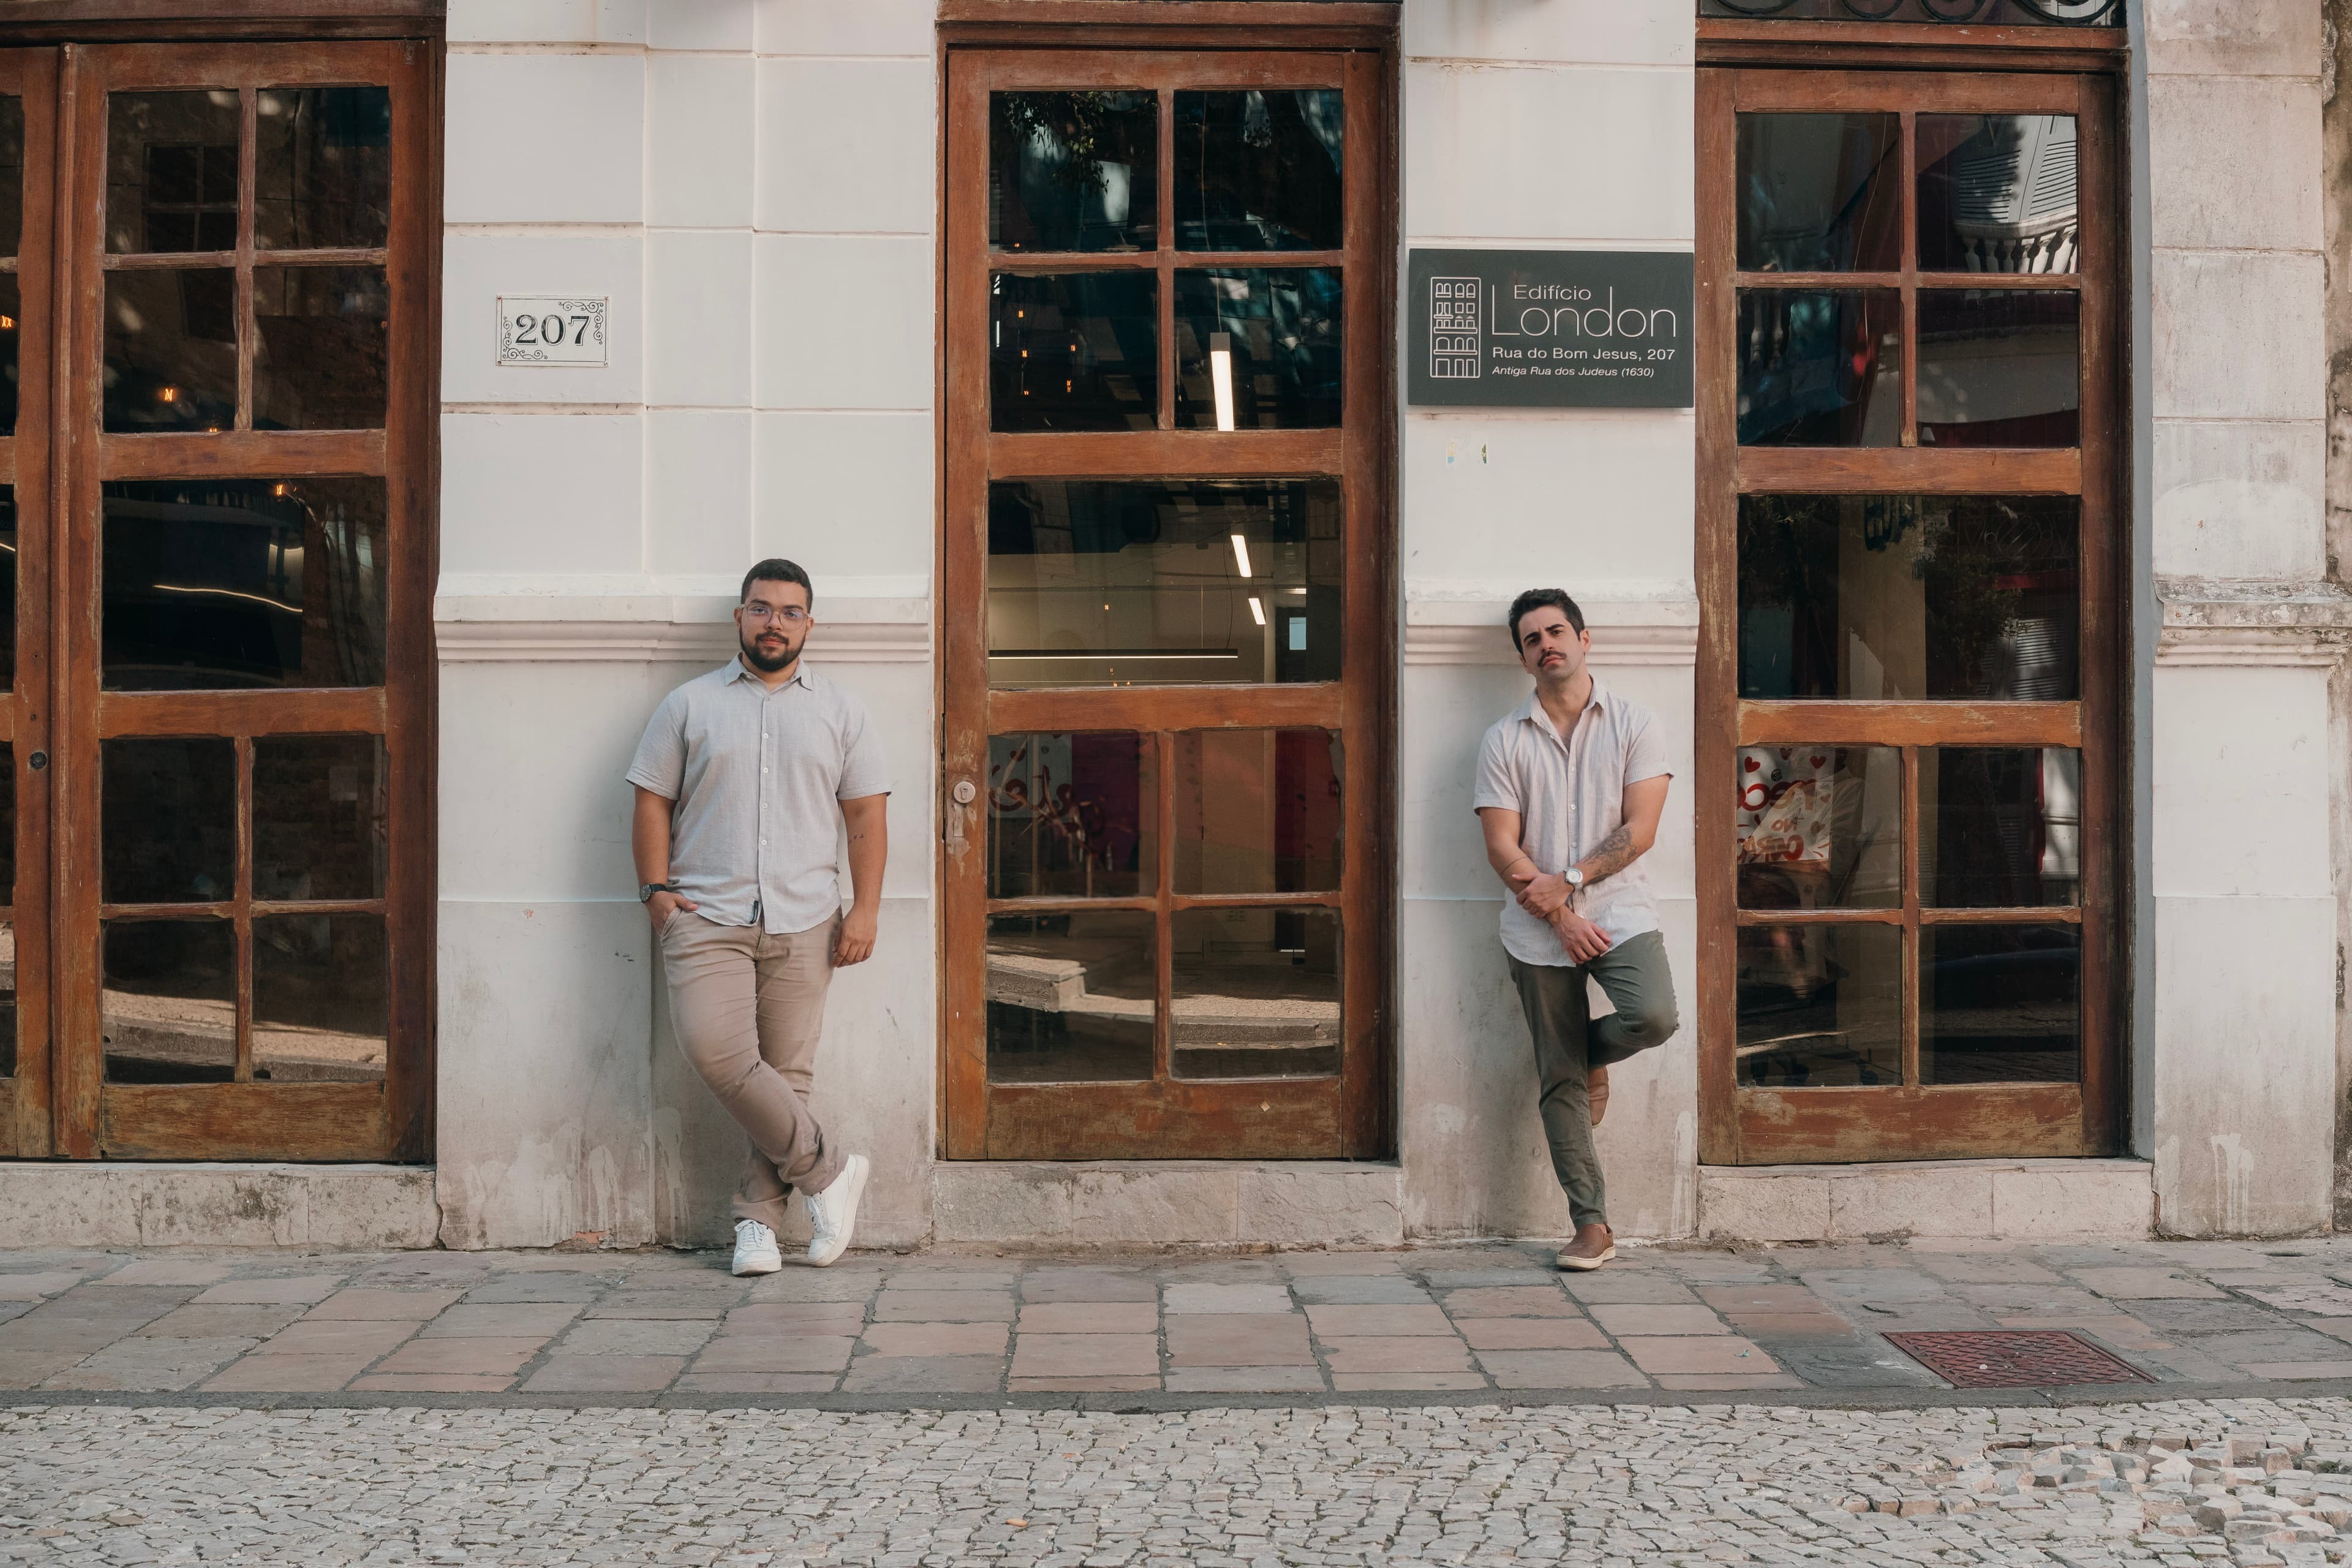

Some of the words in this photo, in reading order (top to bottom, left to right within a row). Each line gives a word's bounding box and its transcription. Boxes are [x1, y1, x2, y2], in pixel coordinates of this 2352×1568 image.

[1514, 284, 1591, 300] Edifício
[1492, 284, 1676, 337] London
[516, 314, 591, 345] 207
[1493, 346, 1522, 358] Rua
[1528, 347, 1547, 359] do
[1553, 347, 1588, 360] Bom
[1593, 349, 1642, 362] Jesus,
[1647, 349, 1675, 360] 207
[1492, 366, 1527, 377] Antiga
[1531, 367, 1551, 375] Rua
[1555, 367, 1575, 375] dos
[1578, 368, 1618, 376] Judeus
[1622, 368, 1654, 378] (1630)
